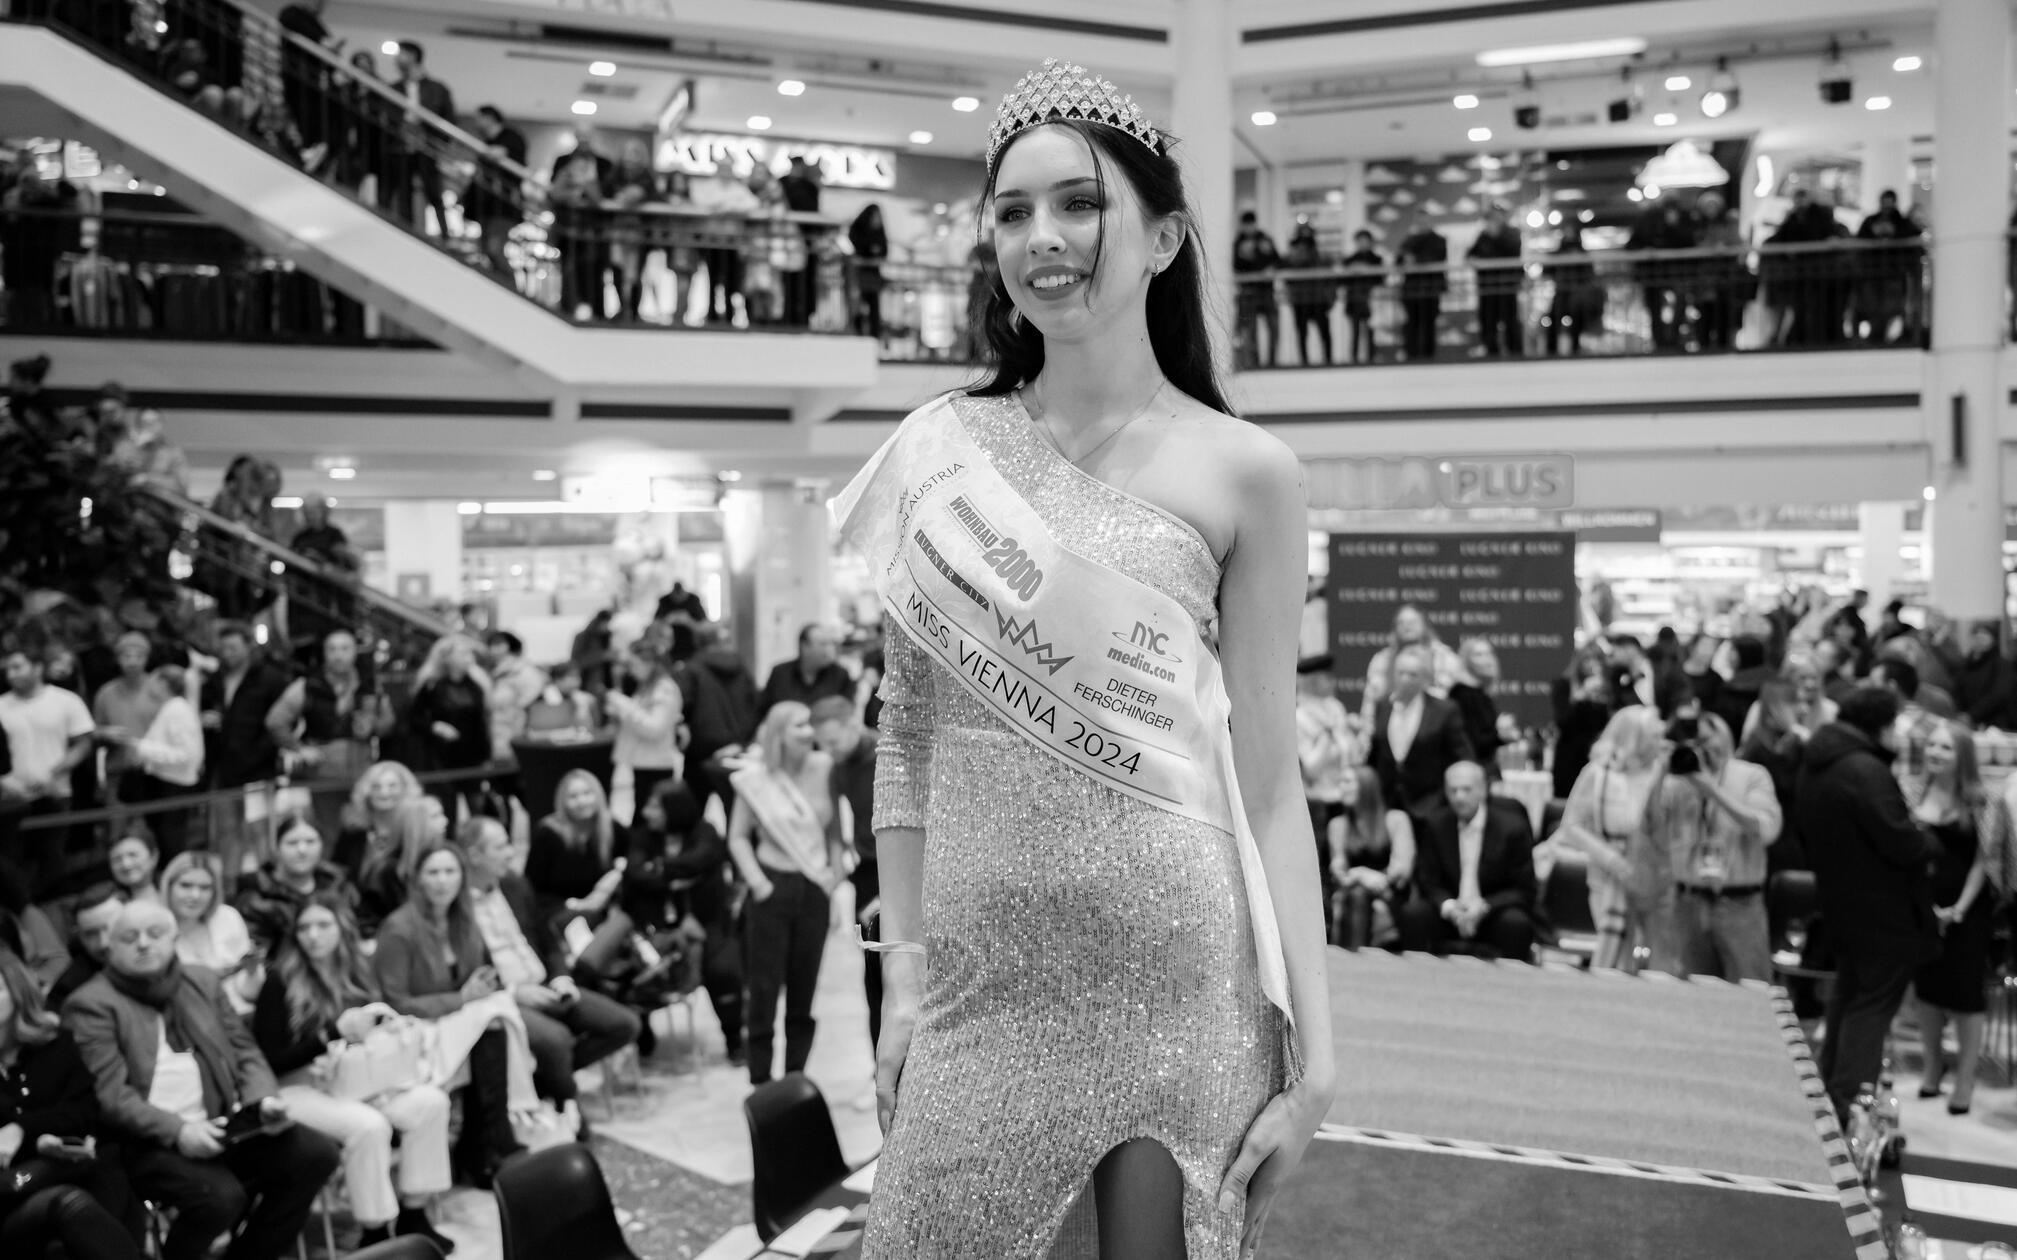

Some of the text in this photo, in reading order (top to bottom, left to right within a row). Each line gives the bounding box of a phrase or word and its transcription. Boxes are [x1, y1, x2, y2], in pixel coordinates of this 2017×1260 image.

[909, 463, 966, 512] AUSTRIA
[1457, 463, 1557, 499] PLUS
[949, 495, 999, 549] WOHNBAU
[982, 537, 1044, 602] 2000
[906, 591, 1142, 775] MISS VIENNA 2024
[1106, 647, 1176, 683] media.con
[1073, 681, 1174, 731] FERSCHINGER
[1106, 677, 1158, 707] DIETER
